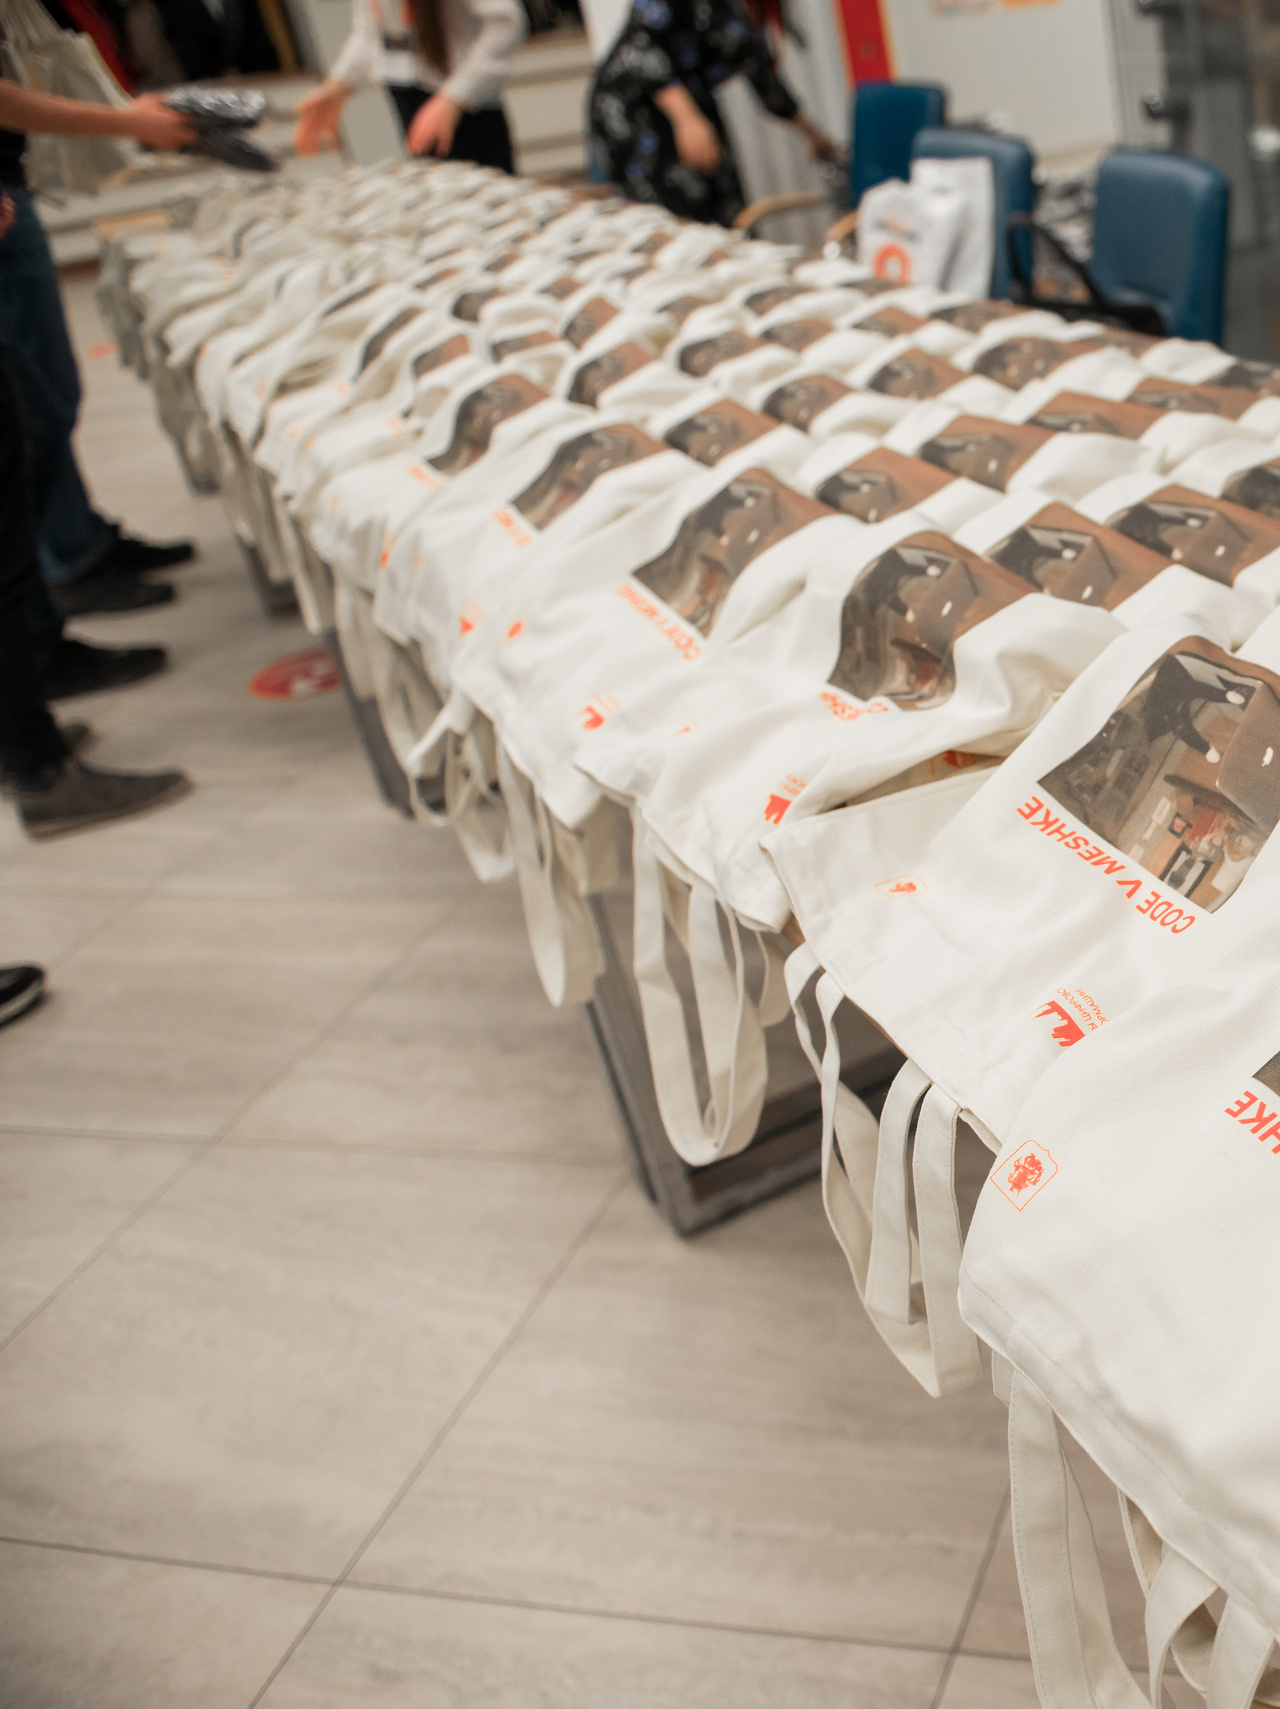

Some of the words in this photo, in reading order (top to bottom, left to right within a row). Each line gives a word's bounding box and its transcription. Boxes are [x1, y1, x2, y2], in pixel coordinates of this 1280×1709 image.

[1016, 795, 1127, 876] MESHKE
[1115, 878, 1143, 900] V
[1135, 890, 1196, 935] CODE
[1055, 987, 1092, 1022] ЦИФРОВО
